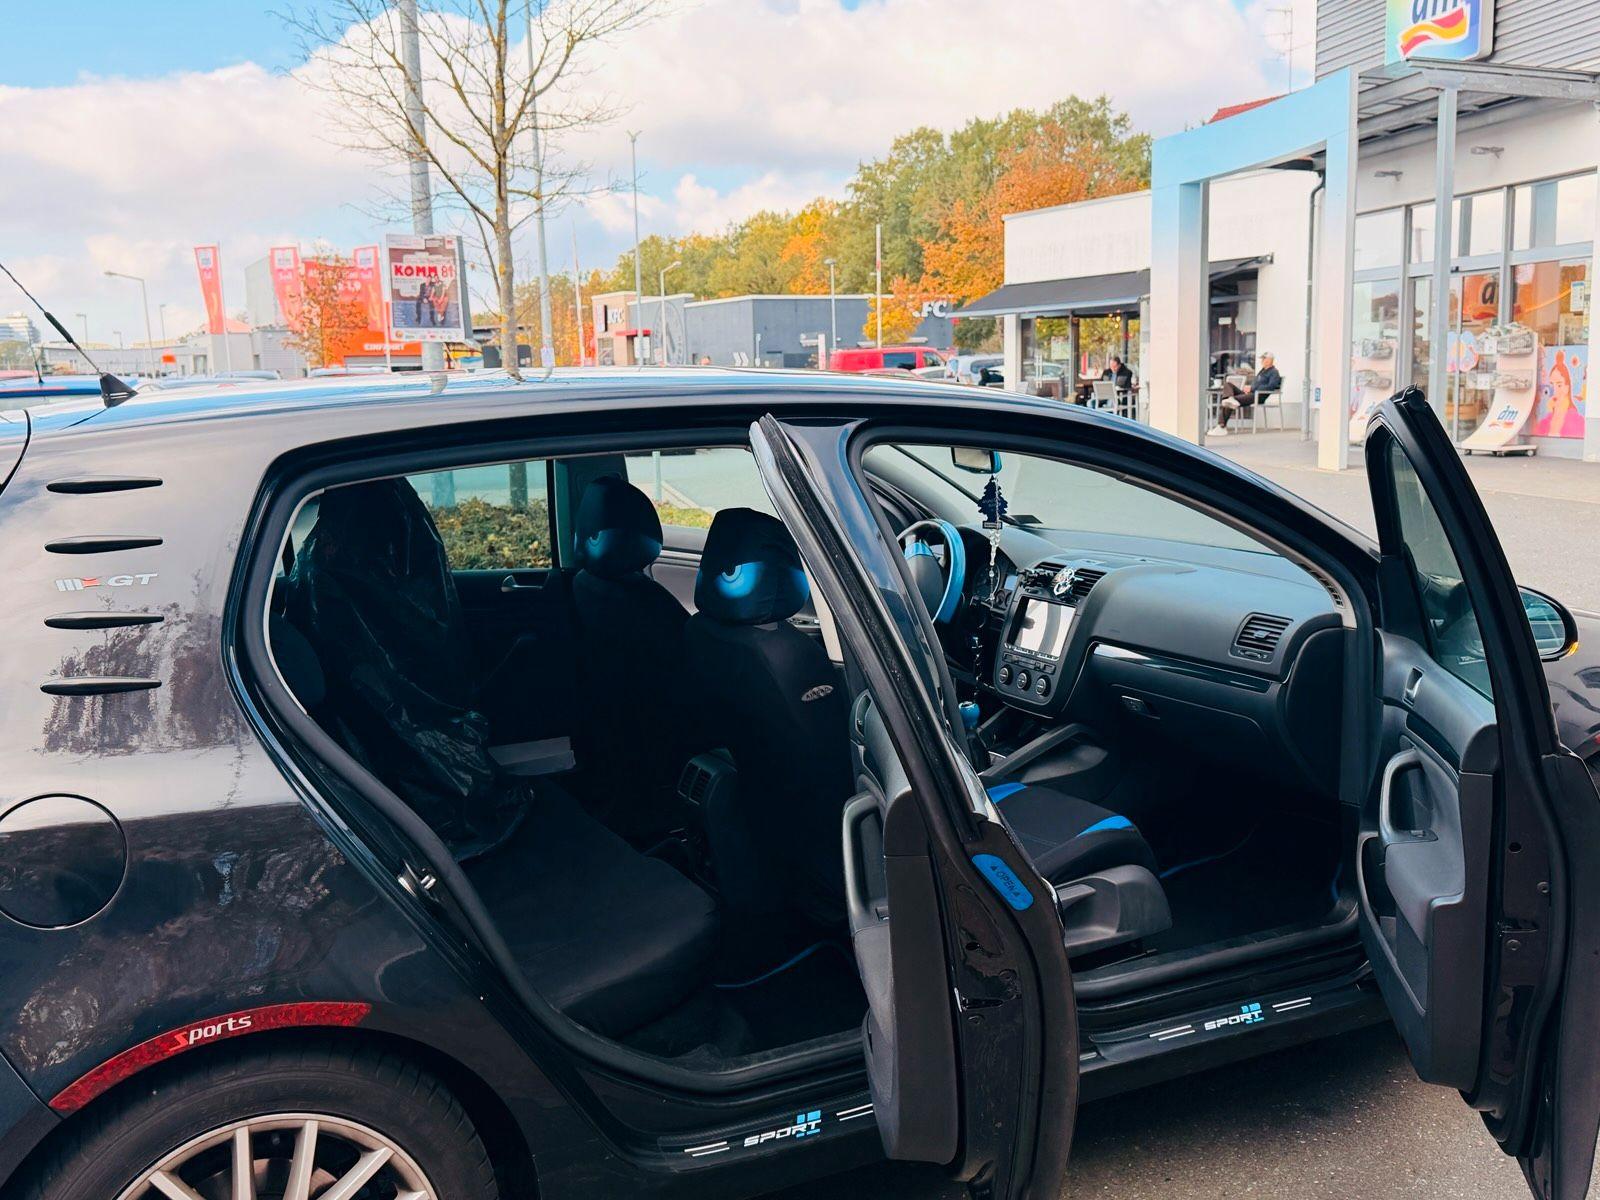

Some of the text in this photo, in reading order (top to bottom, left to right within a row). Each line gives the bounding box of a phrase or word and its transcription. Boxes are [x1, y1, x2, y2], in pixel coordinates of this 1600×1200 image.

[393, 264, 439, 278] KOMM
[912, 300, 948, 318] FC
[1497, 404, 1518, 420] dm
[107, 573, 158, 587] GT
[1204, 1009, 1263, 1031] SPORT
[169, 1015, 252, 1051] Sports
[743, 1119, 822, 1147] SPORT
